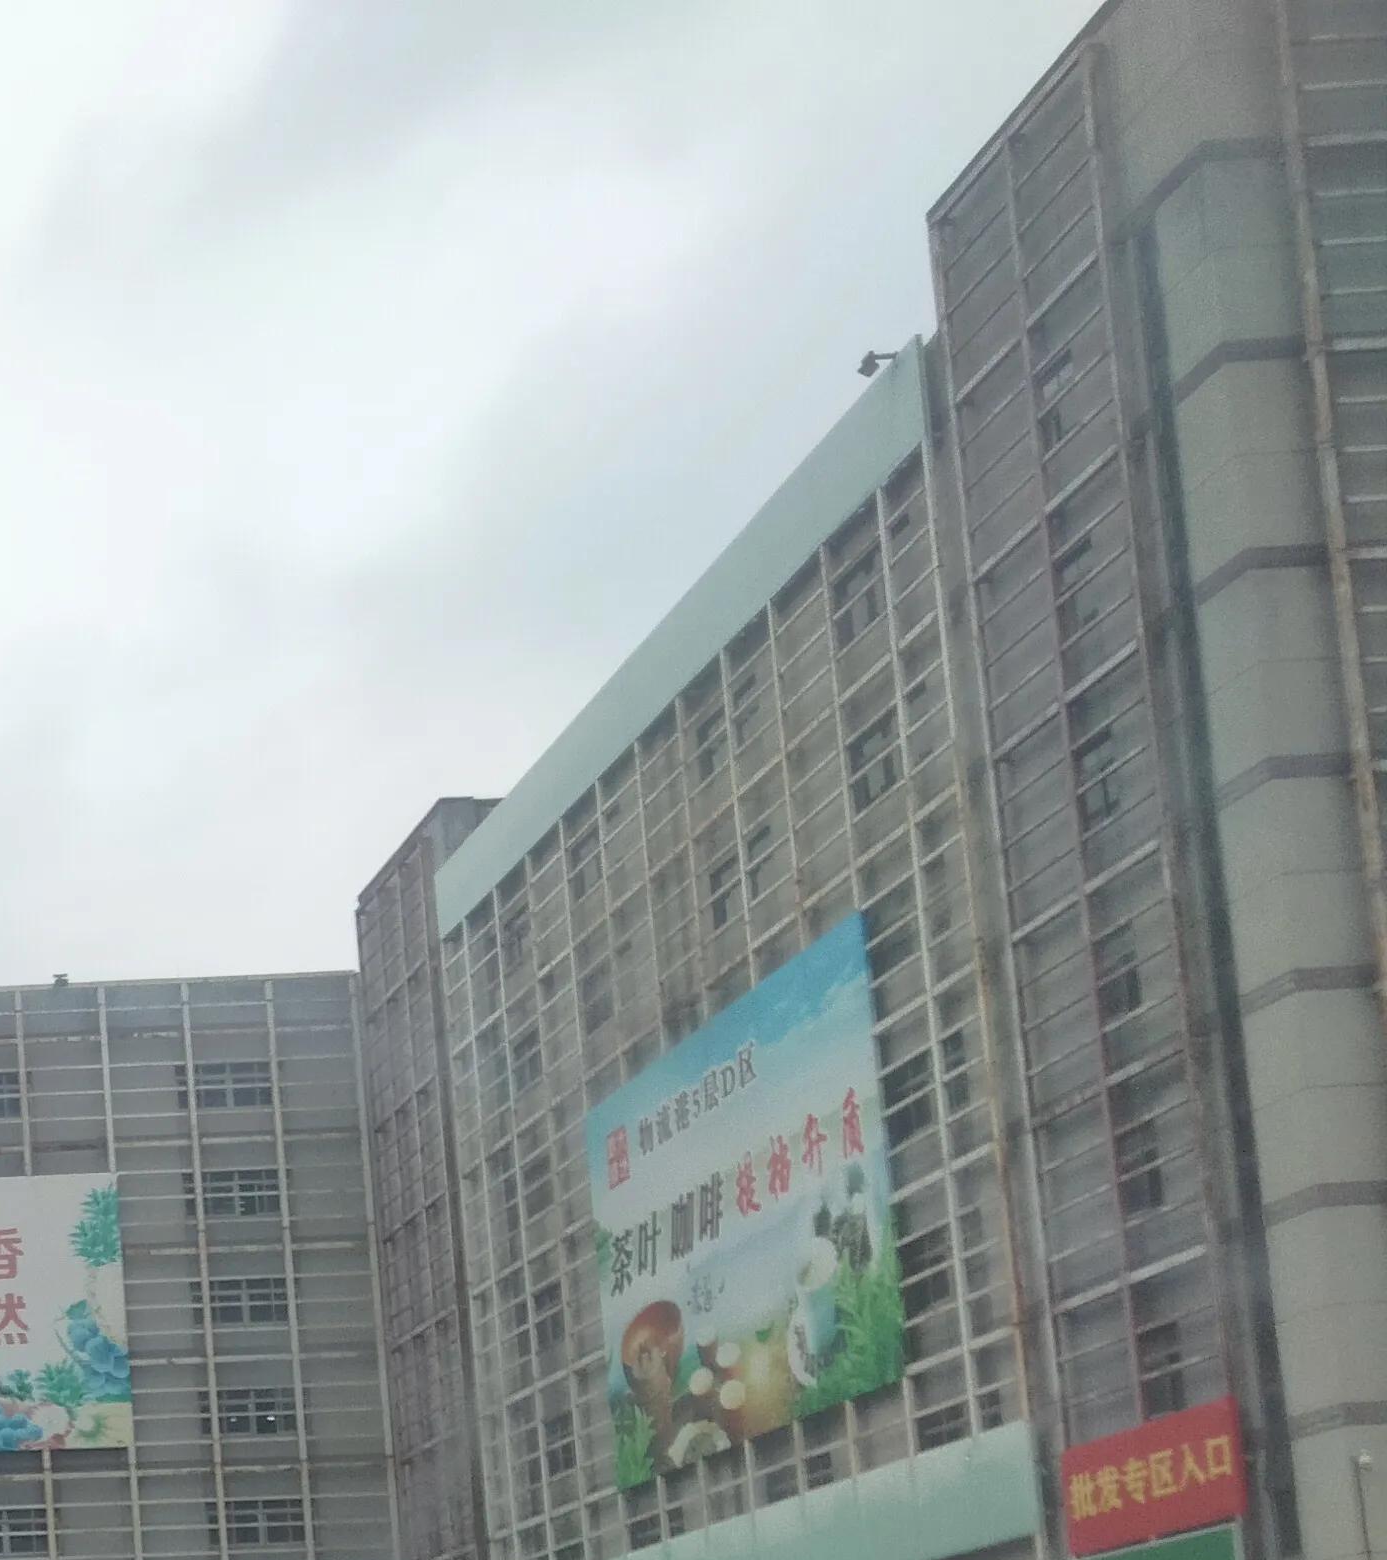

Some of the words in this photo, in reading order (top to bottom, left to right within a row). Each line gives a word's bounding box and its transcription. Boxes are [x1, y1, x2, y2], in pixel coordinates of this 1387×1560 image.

[1069, 1435, 1233, 1521] 批发专区入口
